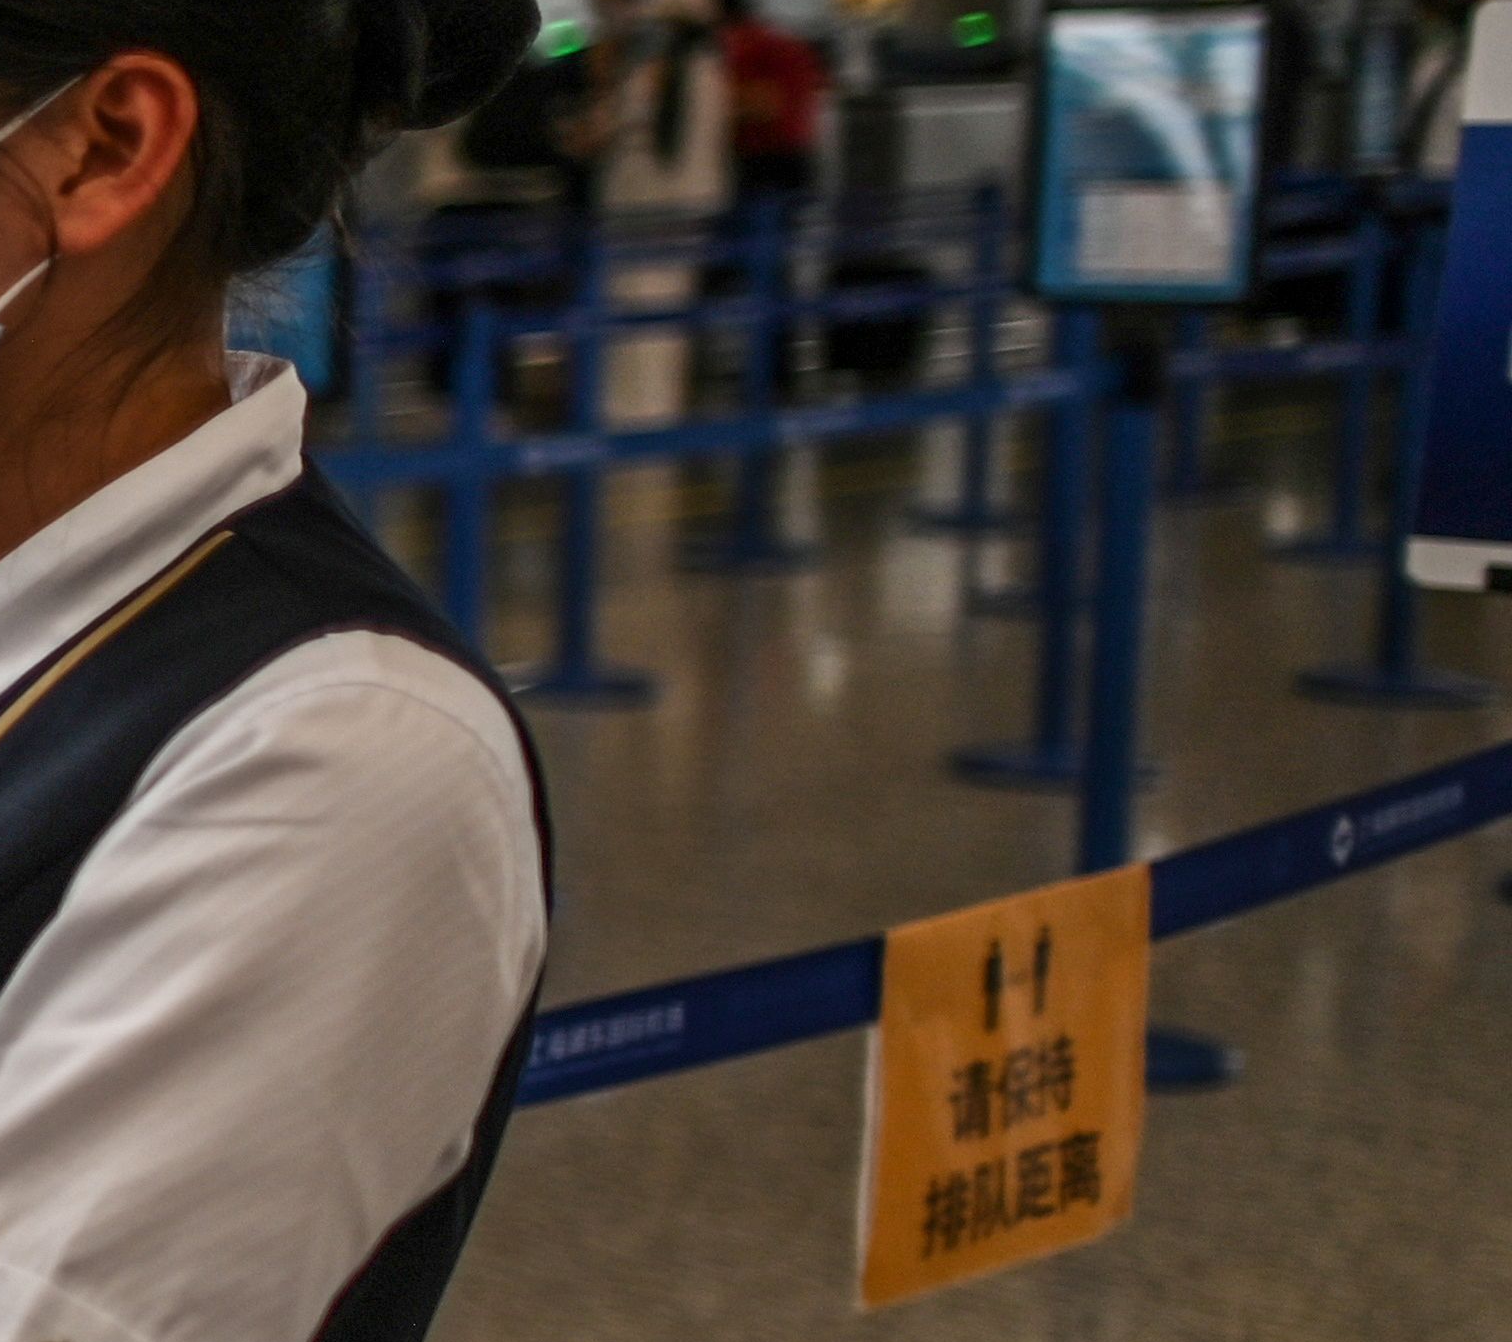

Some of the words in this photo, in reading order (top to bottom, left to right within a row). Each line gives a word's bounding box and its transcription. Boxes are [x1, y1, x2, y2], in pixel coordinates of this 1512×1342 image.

[948, 1035, 1074, 1141] 请保持
[921, 1129, 1103, 1261] 排队距离
